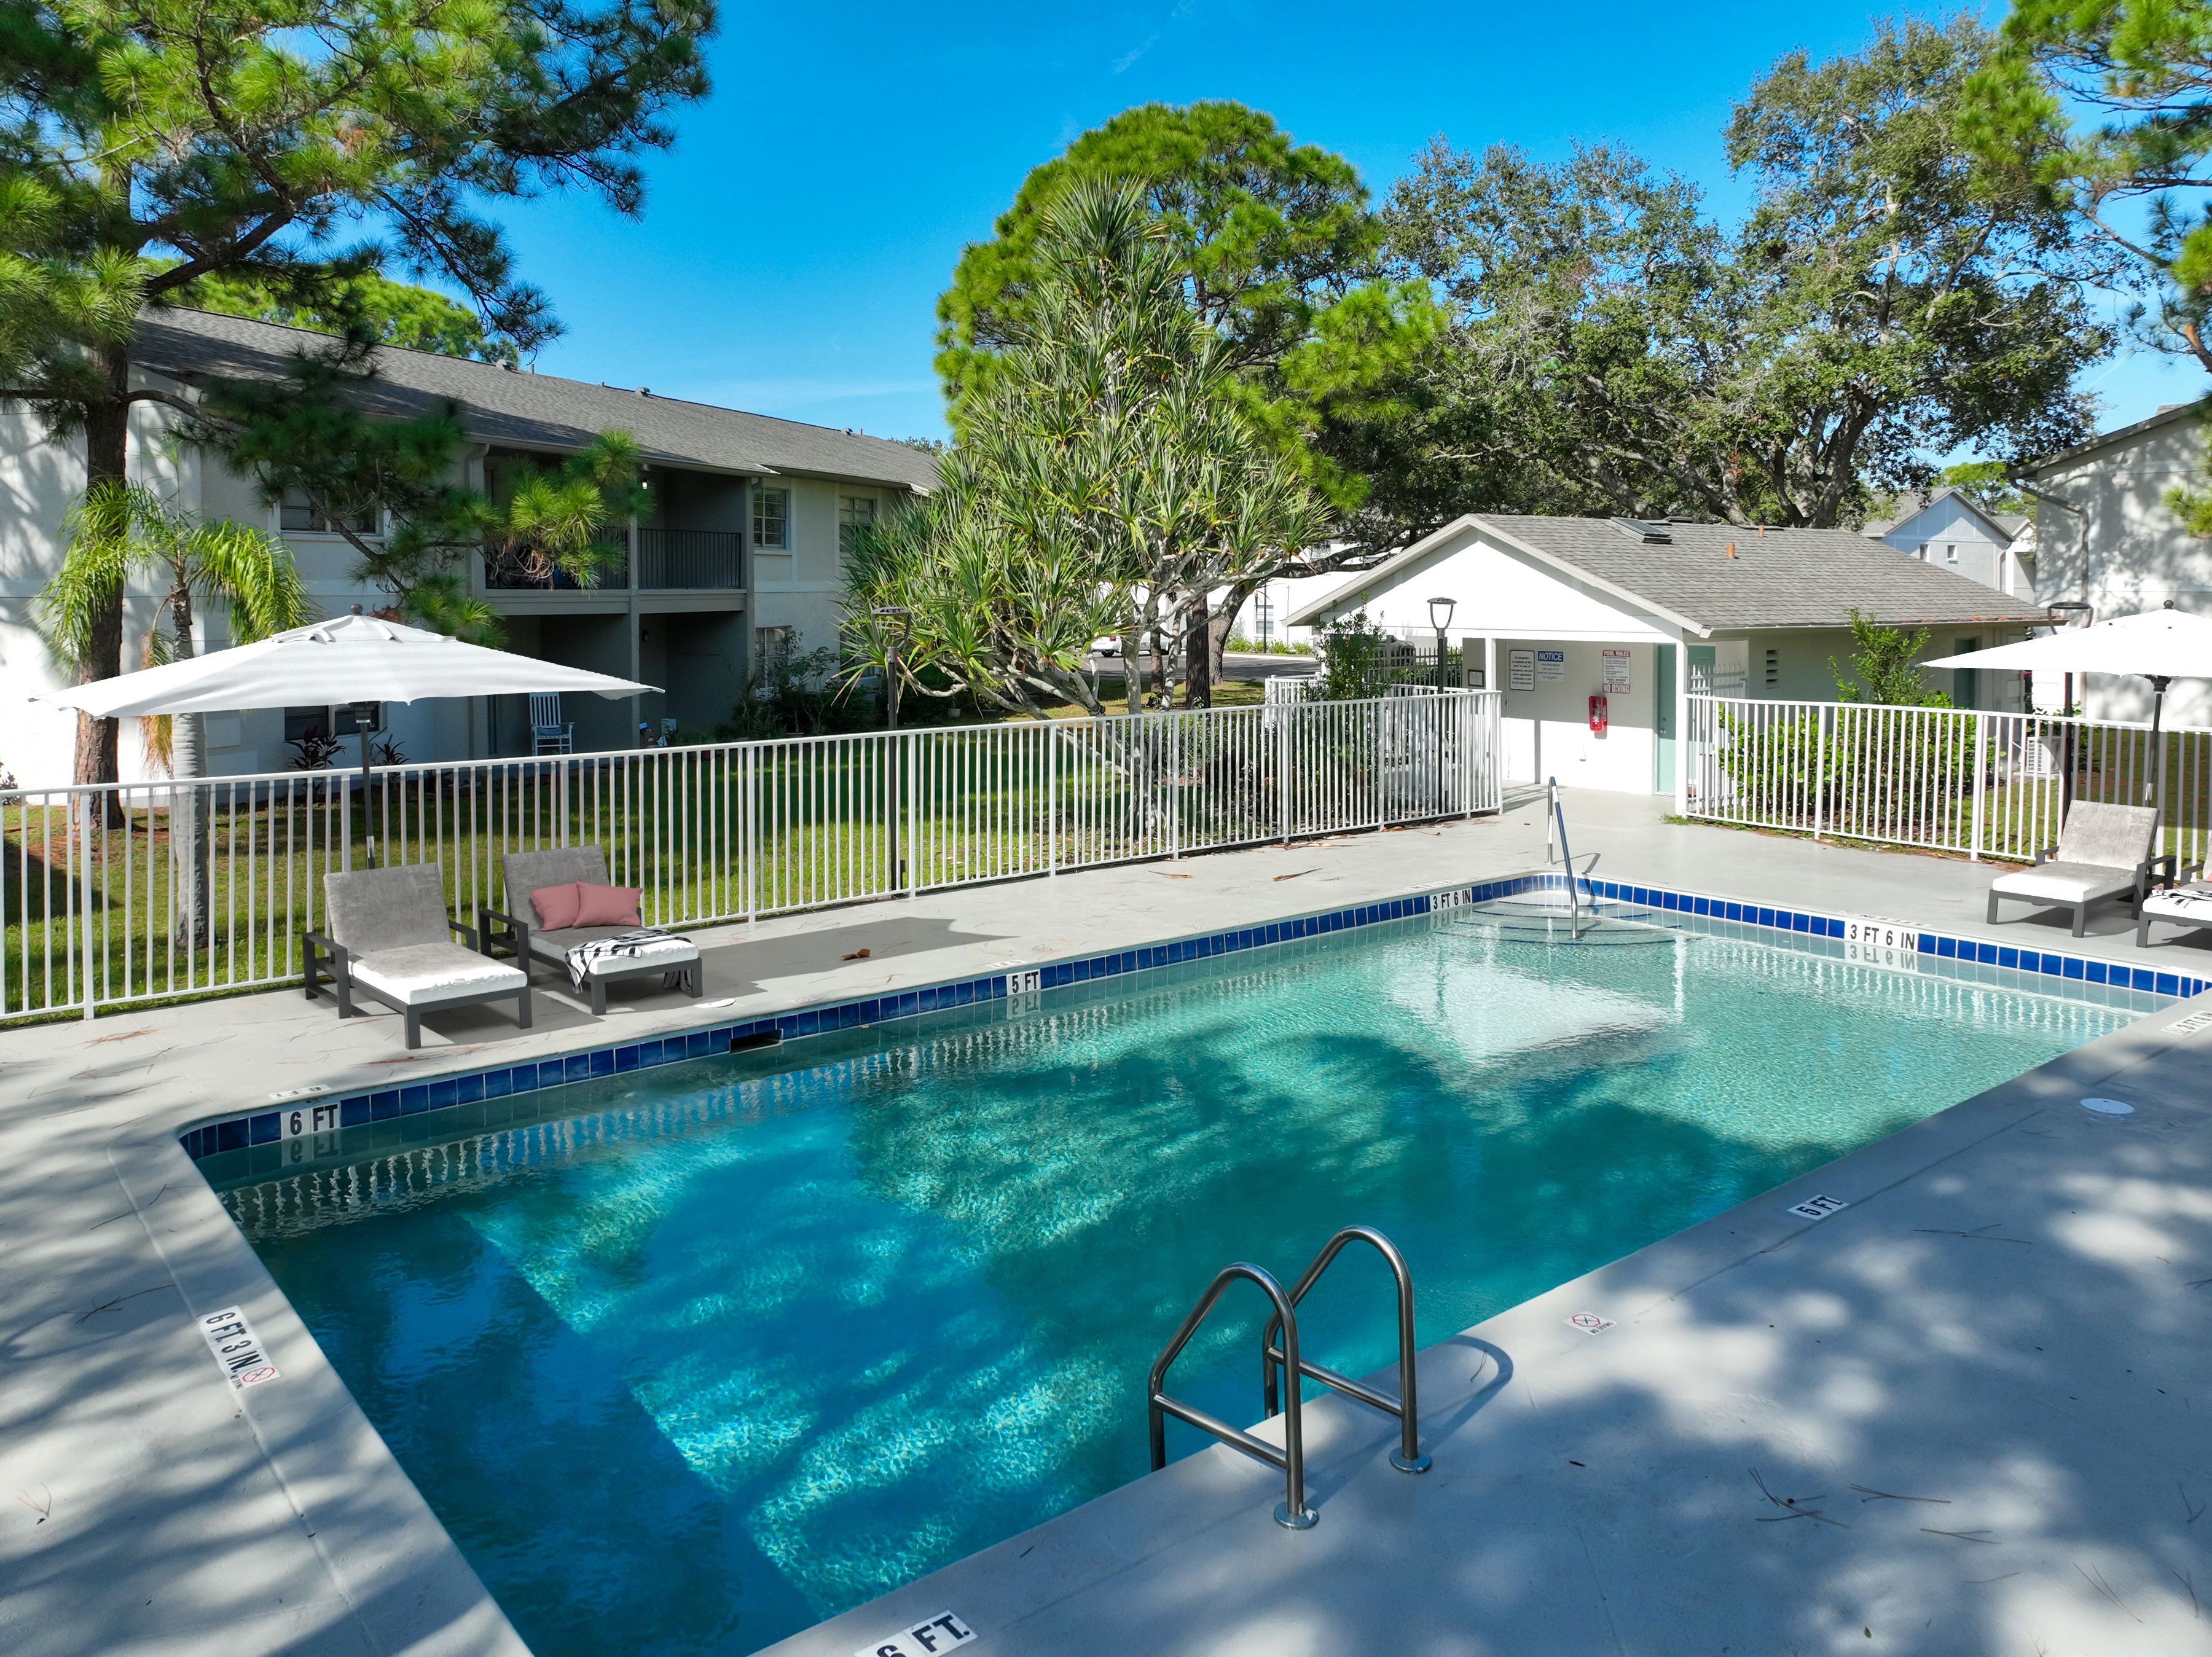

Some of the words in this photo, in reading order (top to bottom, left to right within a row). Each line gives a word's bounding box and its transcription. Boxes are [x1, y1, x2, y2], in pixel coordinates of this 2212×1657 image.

[1539, 652, 1563, 660] NOTICE
[1603, 684, 1610, 692] NO
[1612, 684, 1630, 694] DIVING
[1433, 896, 1438, 909] 3
[1441, 893, 1450, 909] FT
[1454, 891, 1459, 906] 6
[1462, 889, 1471, 904] IN
[1850, 924, 1857, 939] 3
[1864, 926, 1879, 943] FT
[1886, 930, 1893, 946] 6
[1900, 932, 1915, 950] IN
[1012, 975, 1019, 993] 5
[1024, 971, 1038, 991] FT
[290, 1111, 302, 1135] 6
[313, 1104, 338, 1132] FT
[1795, 1206, 1822, 1216] 5
[206, 1312, 236, 1324] 6
[211, 1322, 247, 1342] FT.
[221, 1340, 252, 1353] 3
[912, 1615, 970, 1653] FT.
